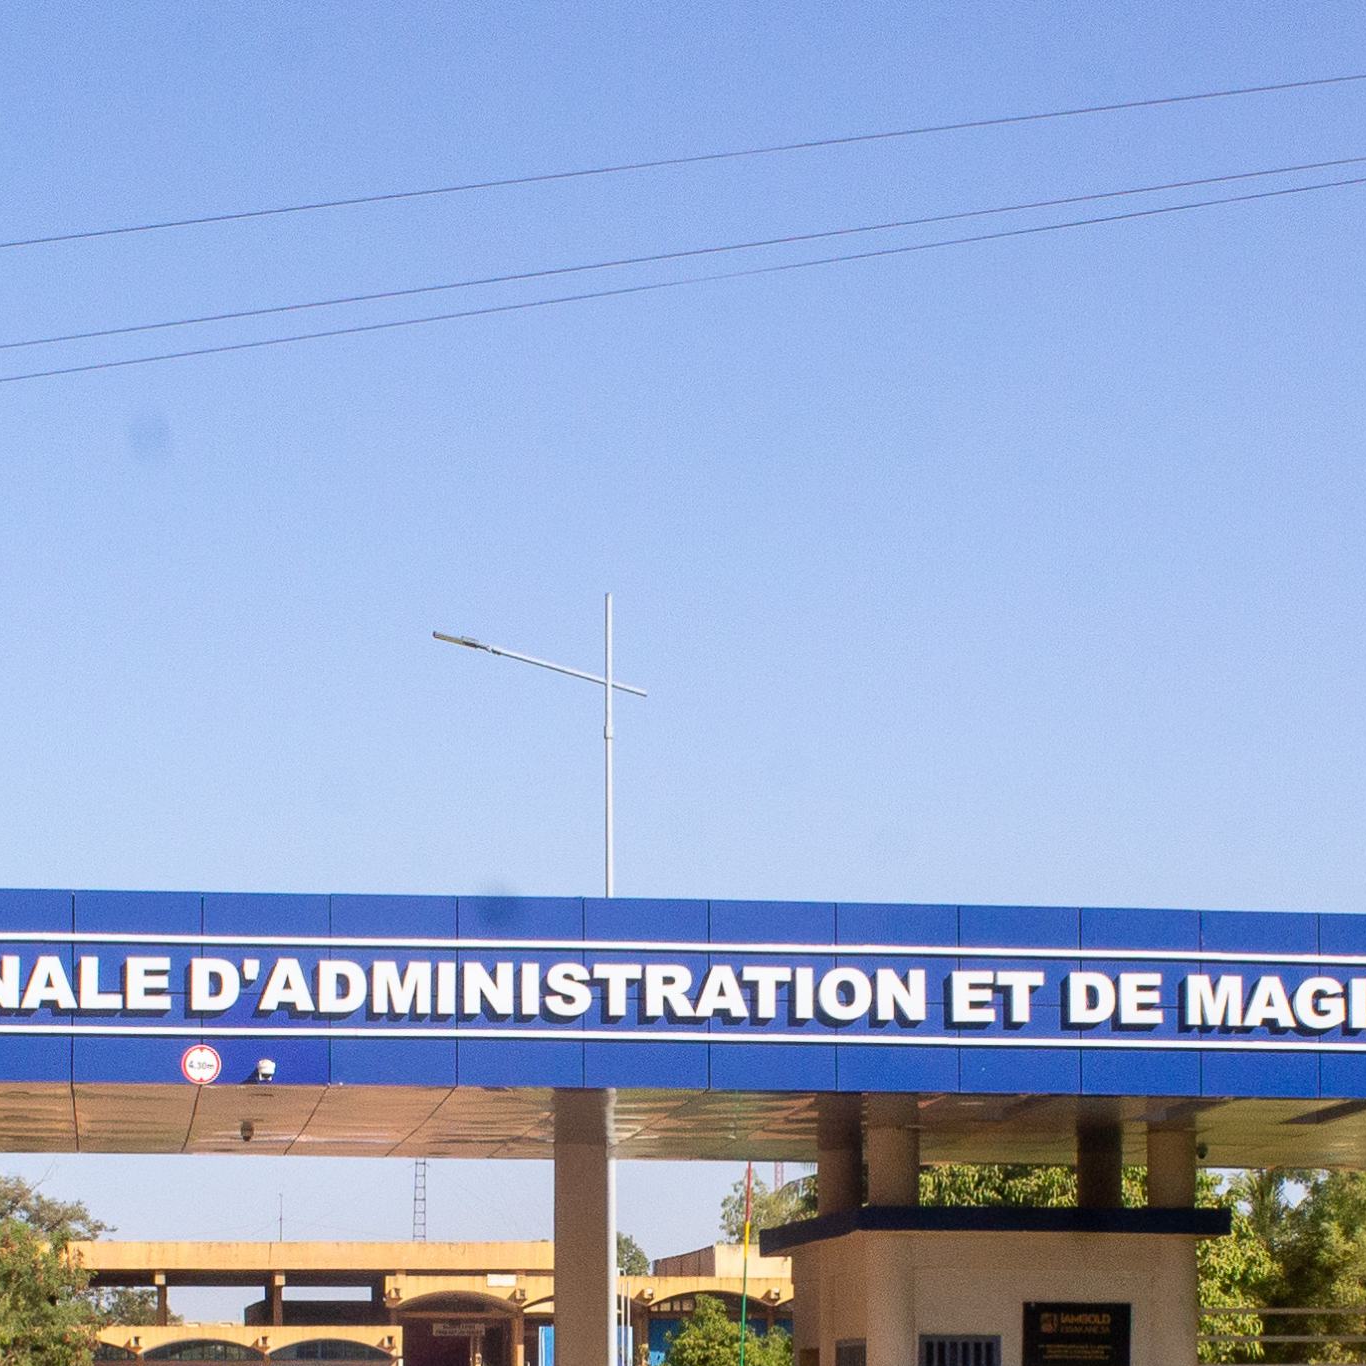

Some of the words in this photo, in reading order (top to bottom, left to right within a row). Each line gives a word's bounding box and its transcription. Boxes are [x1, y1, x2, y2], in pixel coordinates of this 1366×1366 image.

[190, 956, 927, 1020] D'ADMINISTRATION
[952, 969, 1044, 1022] ET
[1069, 971, 1163, 1024] DE
